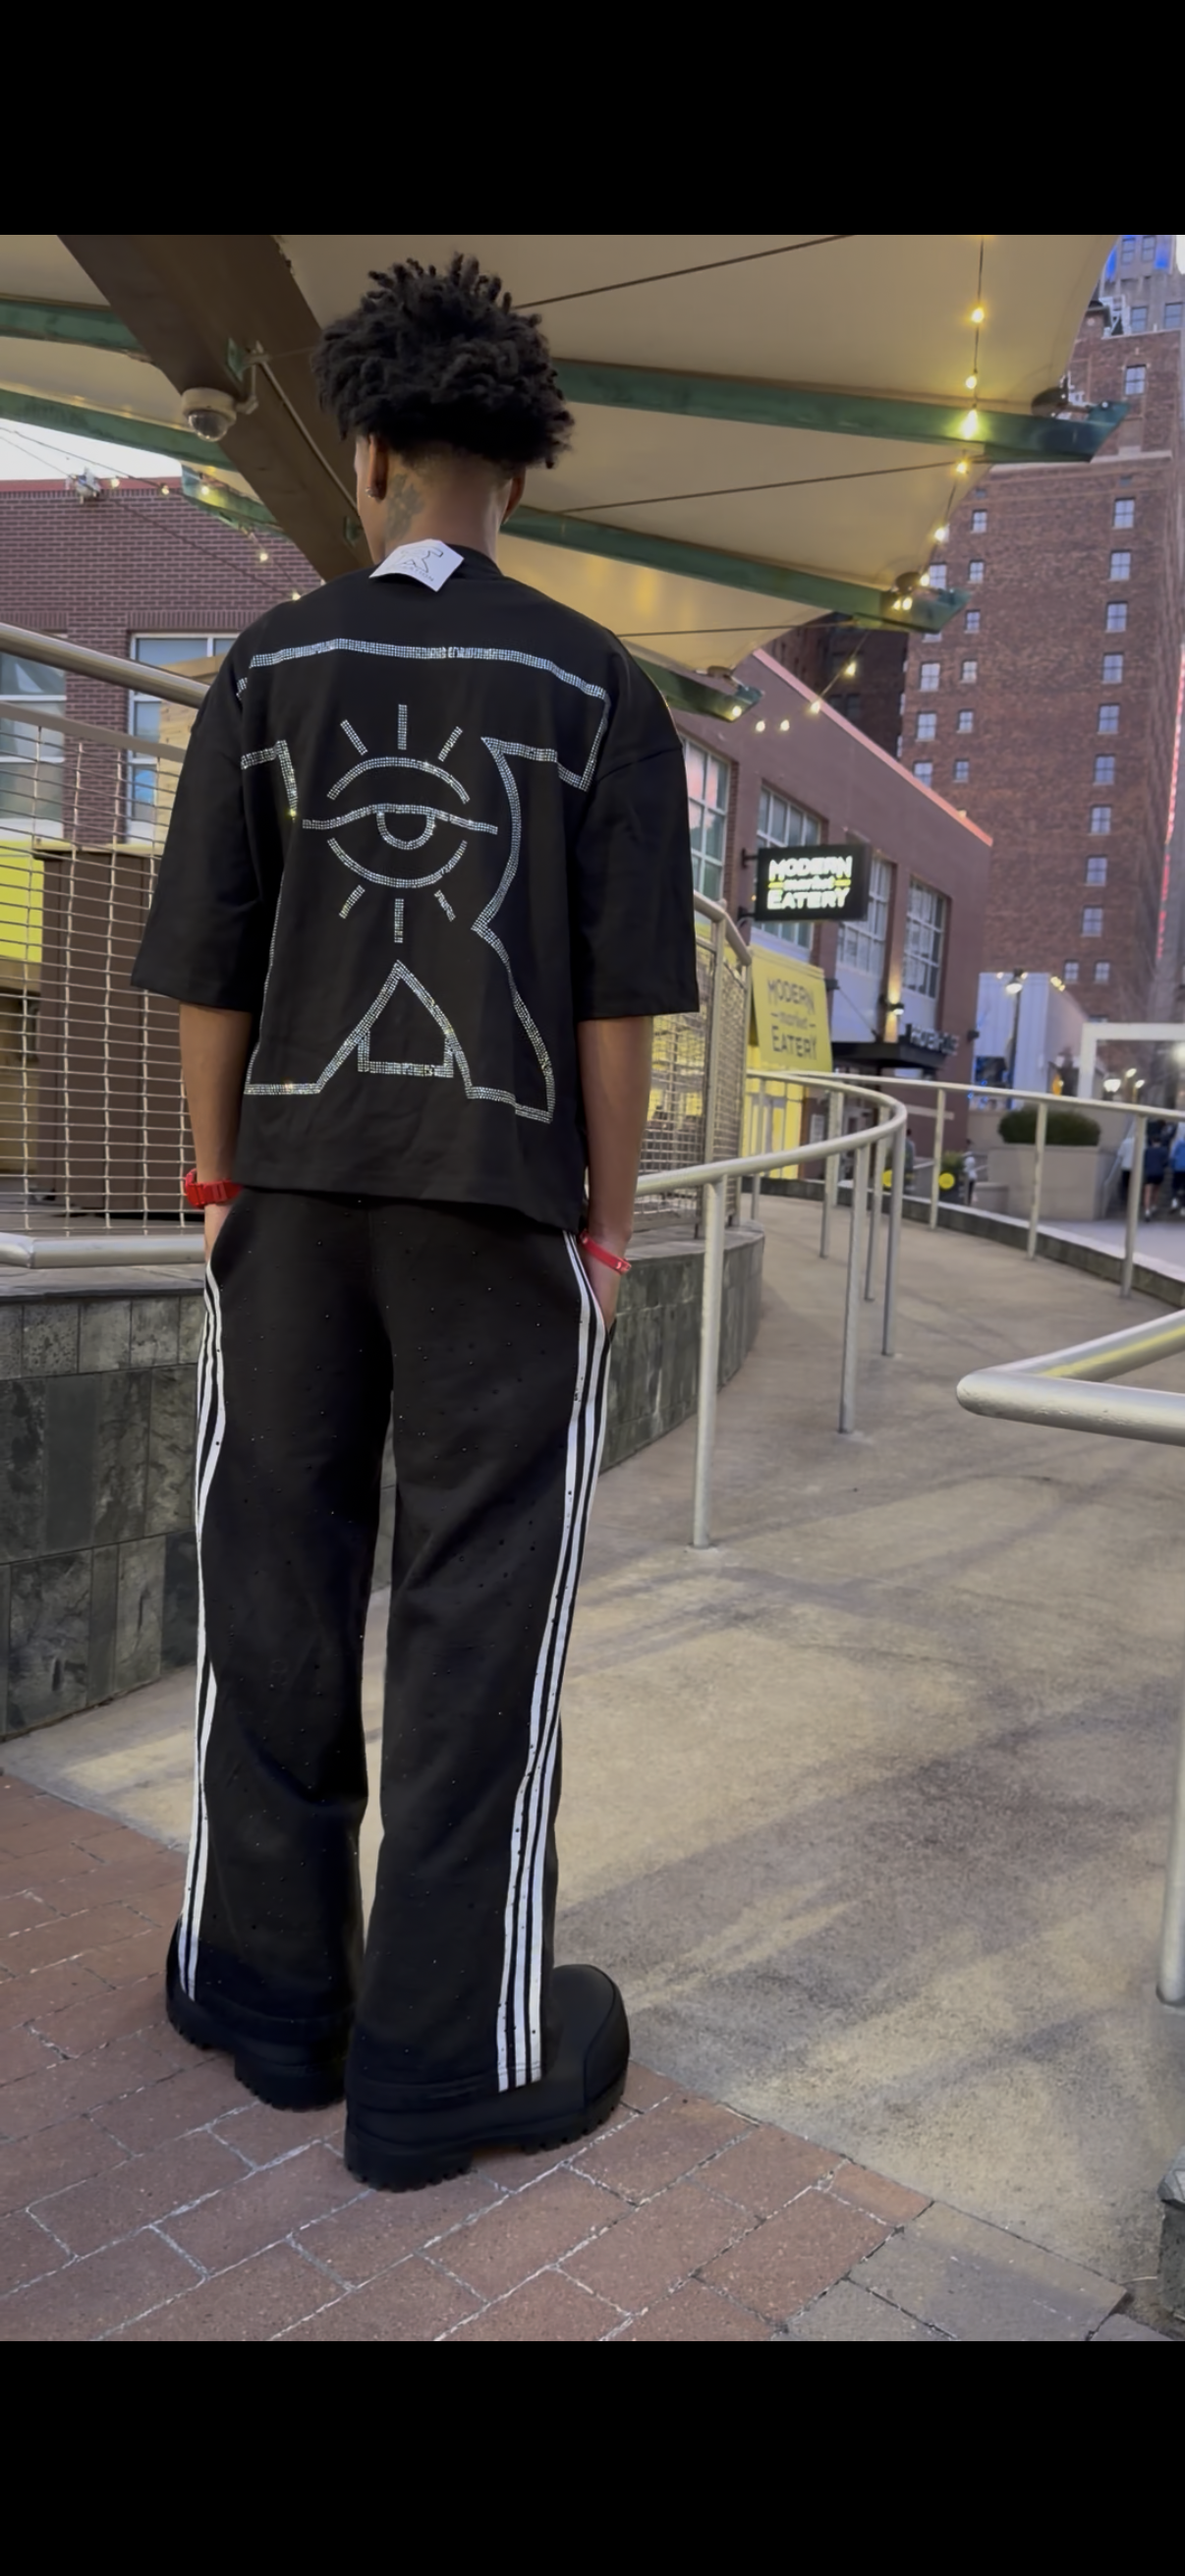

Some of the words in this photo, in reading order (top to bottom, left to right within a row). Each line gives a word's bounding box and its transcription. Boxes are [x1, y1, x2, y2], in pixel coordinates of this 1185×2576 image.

[768, 855, 852, 881] MODERN
[766, 886, 850, 910] EATERY
[767, 979, 816, 1014] MODERN
[771, 1025, 818, 1060] EATERY
